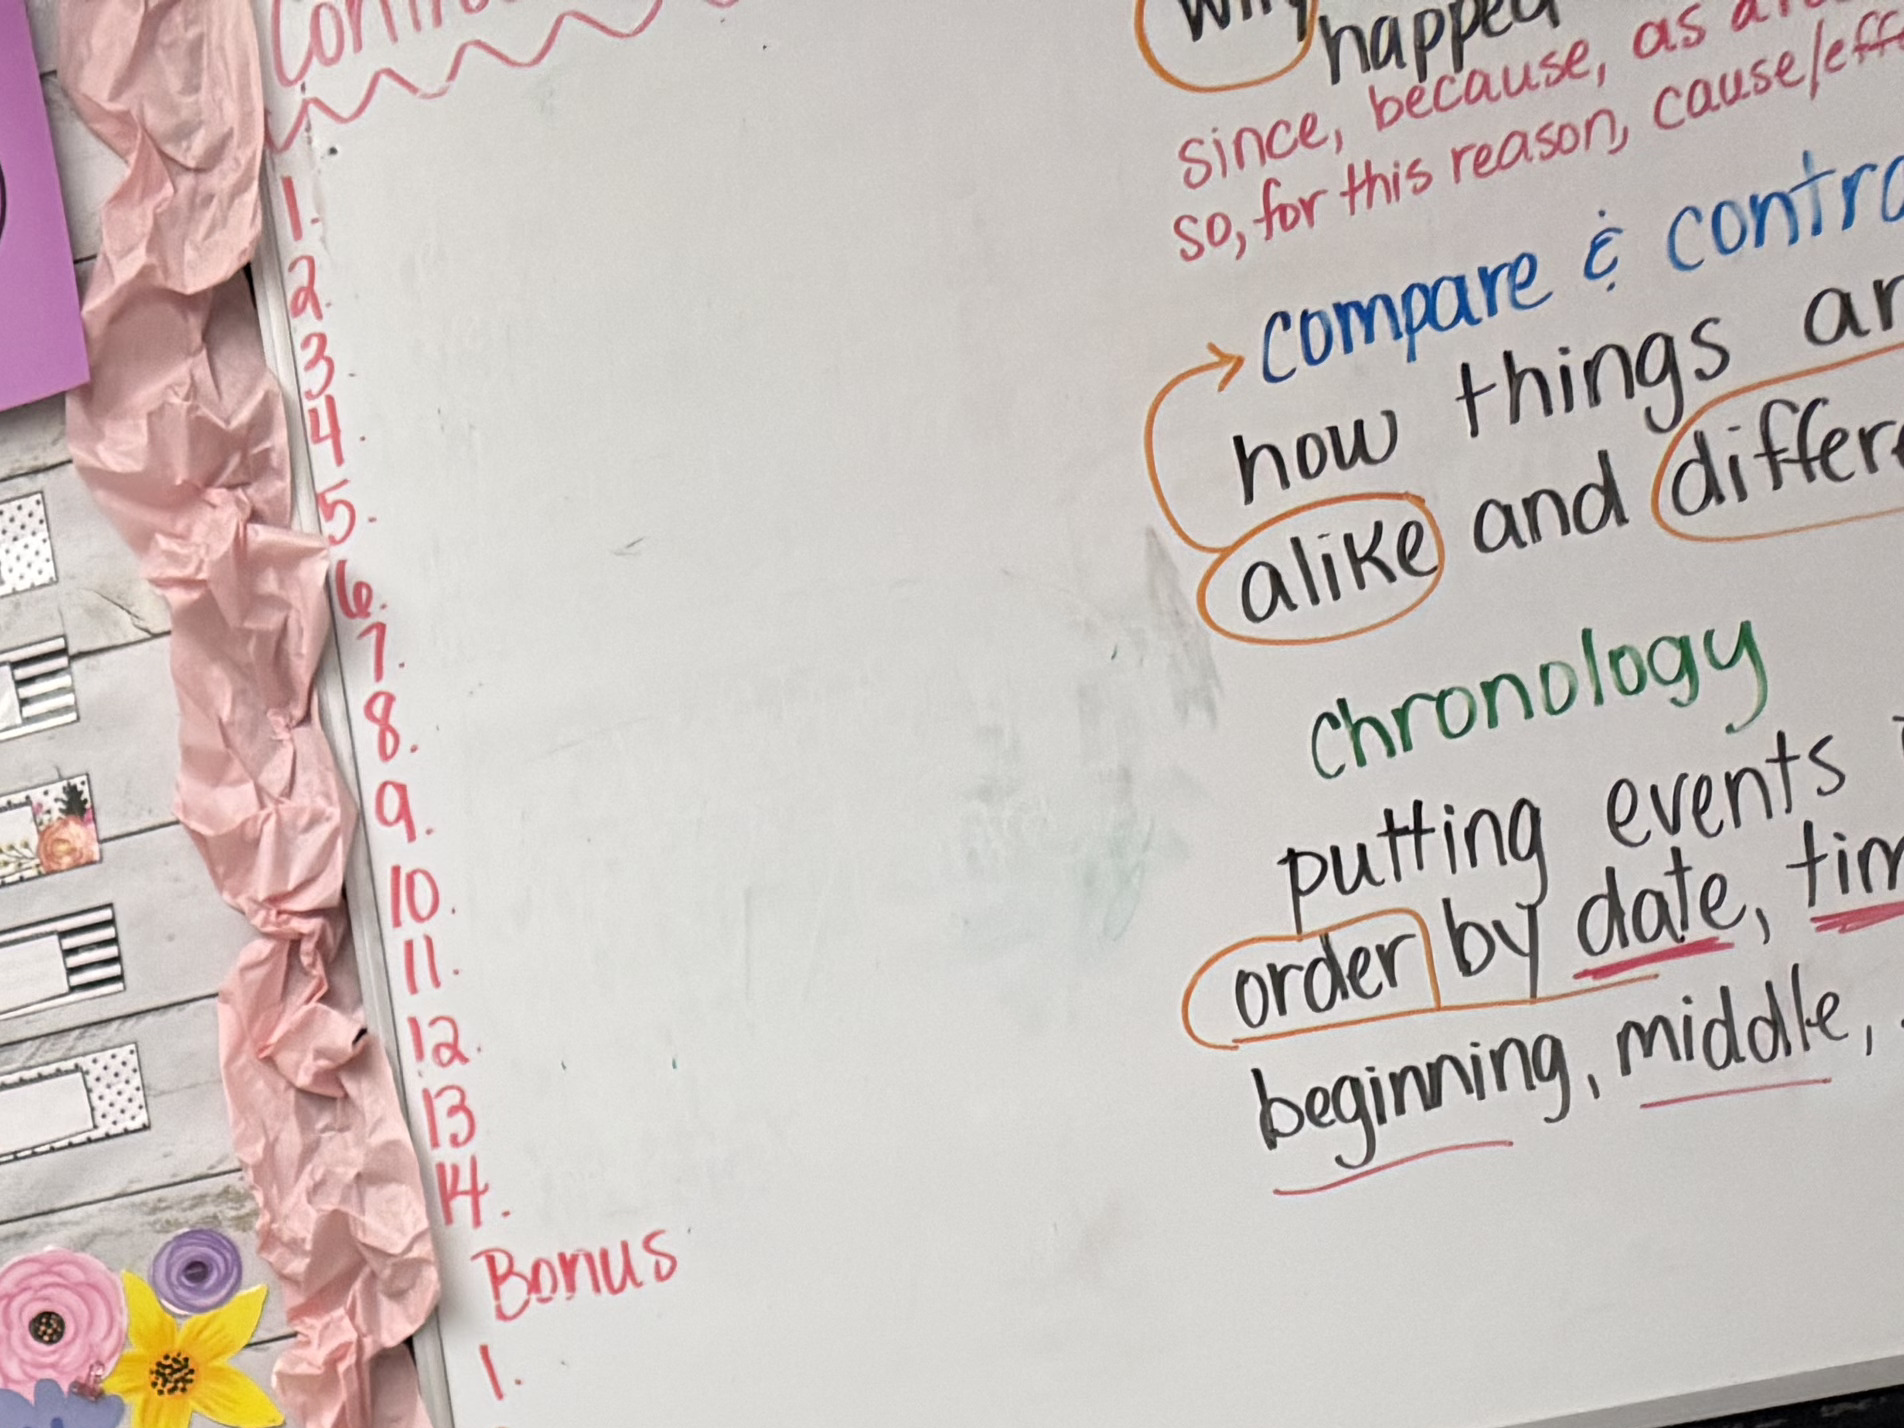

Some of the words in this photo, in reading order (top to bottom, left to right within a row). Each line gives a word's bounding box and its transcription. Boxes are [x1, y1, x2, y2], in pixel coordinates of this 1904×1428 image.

[1179, 110, 1342, 189] since,
[1370, 39, 1605, 131] because,
[1633, 4, 1706, 59] as
[1256, 174, 1320, 241] for
[1340, 159, 1433, 220] this
[1451, 107, 1629, 184] reason,
[1654, 10, 1904, 130] cause/eff
[1234, 408, 1398, 505] how
[1456, 317, 1731, 437] things
[1241, 515, 1437, 624] alike
[1473, 450, 1629, 556] and
[1279, 798, 1548, 937] putting
[1605, 730, 1847, 846] events
[1234, 932, 1417, 1028] order
[1442, 898, 1540, 1000] by
[1578, 846, 1771, 957] date,
[422, 1086, 476, 1150] 13
[1252, 1034, 1600, 1170] beginning,
[1617, 963, 1873, 1078] middle,
[470, 1228, 678, 1321] Bonus
